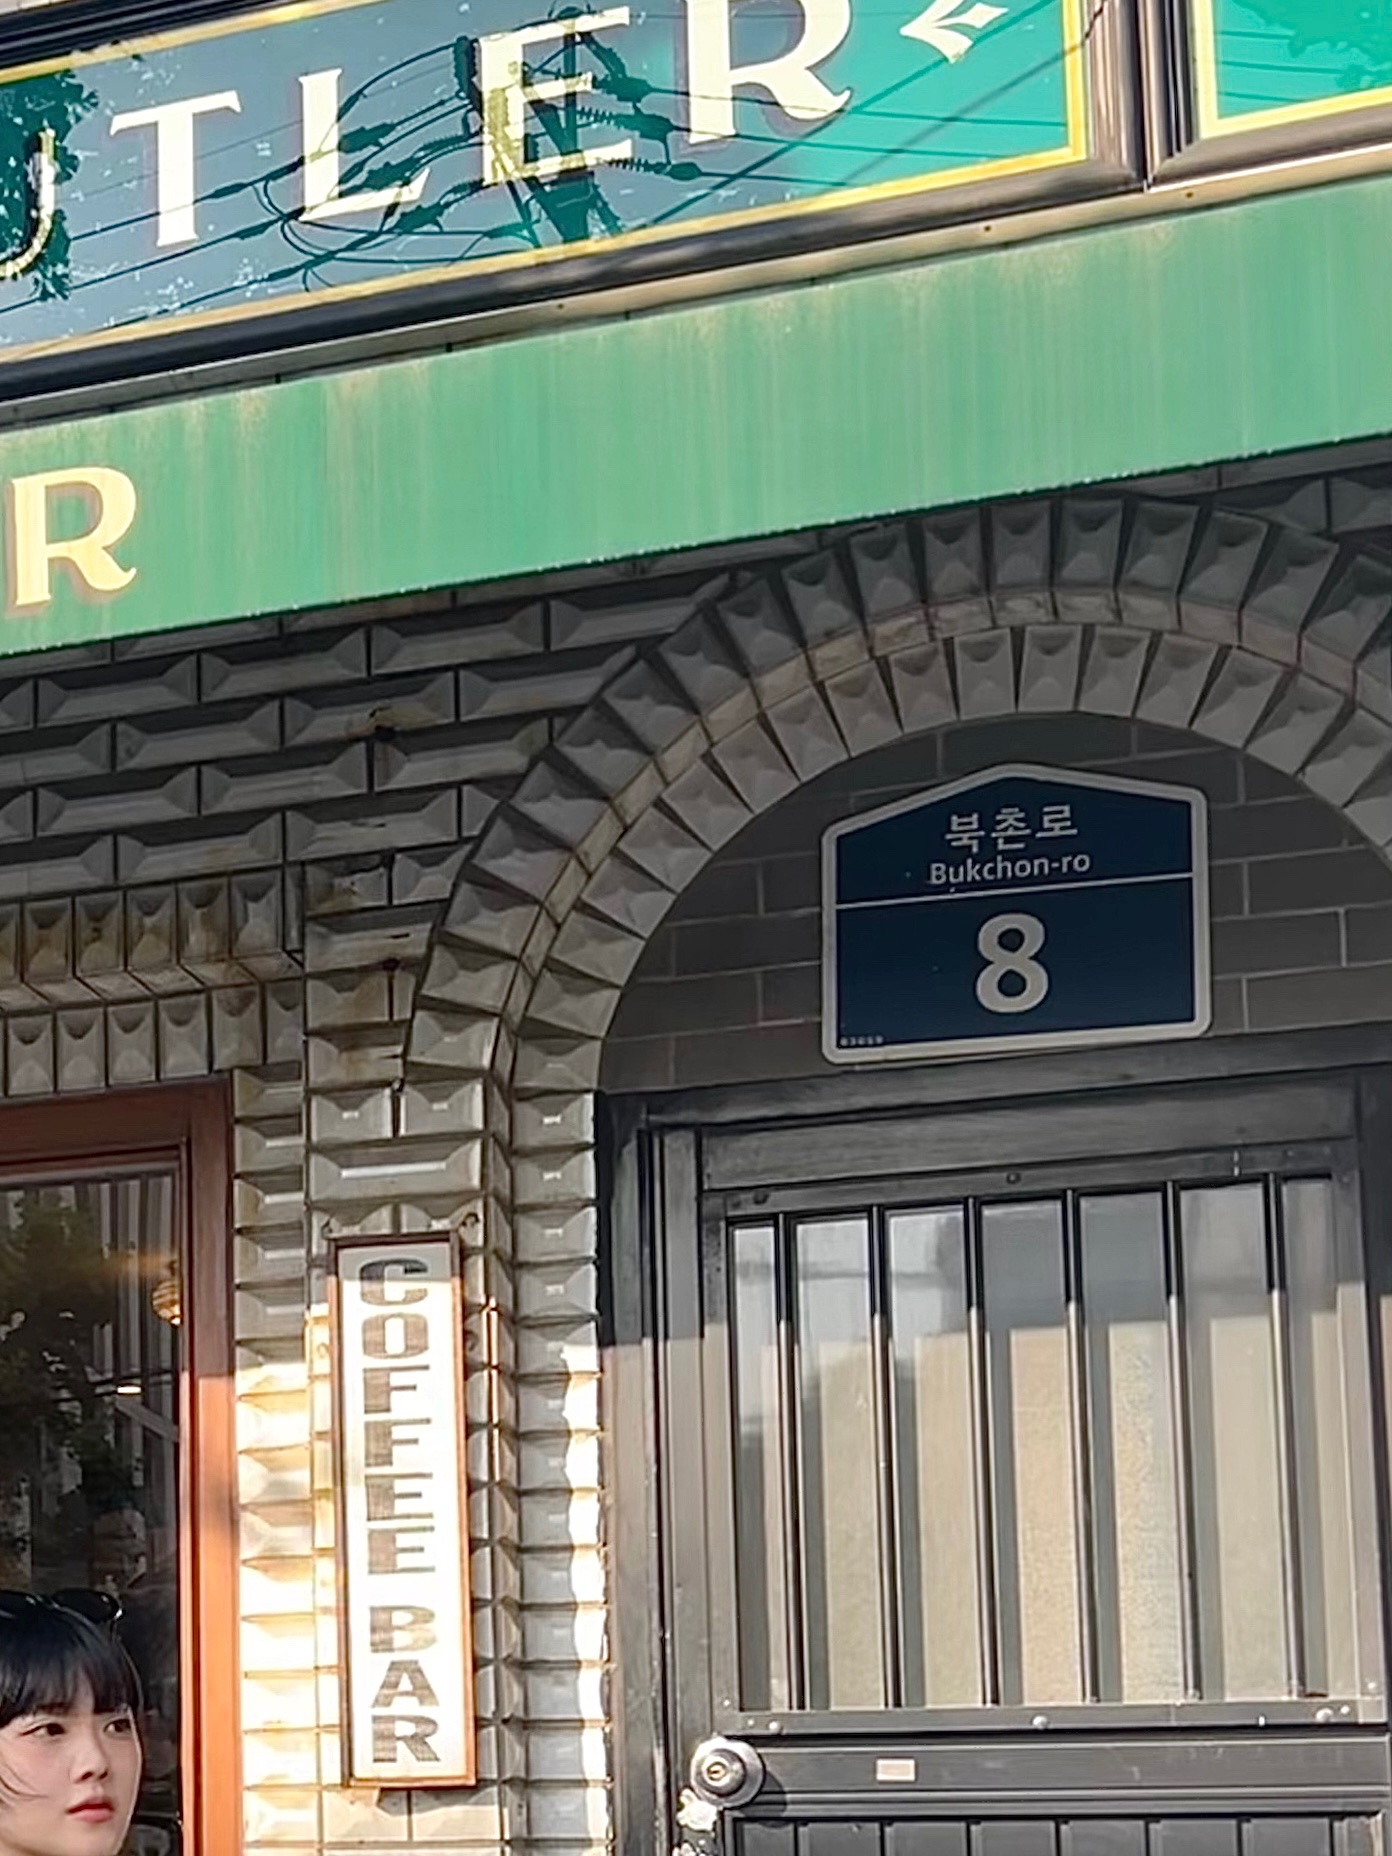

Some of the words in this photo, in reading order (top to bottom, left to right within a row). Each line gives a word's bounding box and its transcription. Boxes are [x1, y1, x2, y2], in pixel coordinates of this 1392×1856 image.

[929, 854, 1092, 885] Bukchon-ro
[945, 804, 1079, 854] 북촌로
[975, 913, 1050, 1014] 8
[359, 1258, 437, 1576] COFFEE
[368, 1605, 441, 1764] BAR
